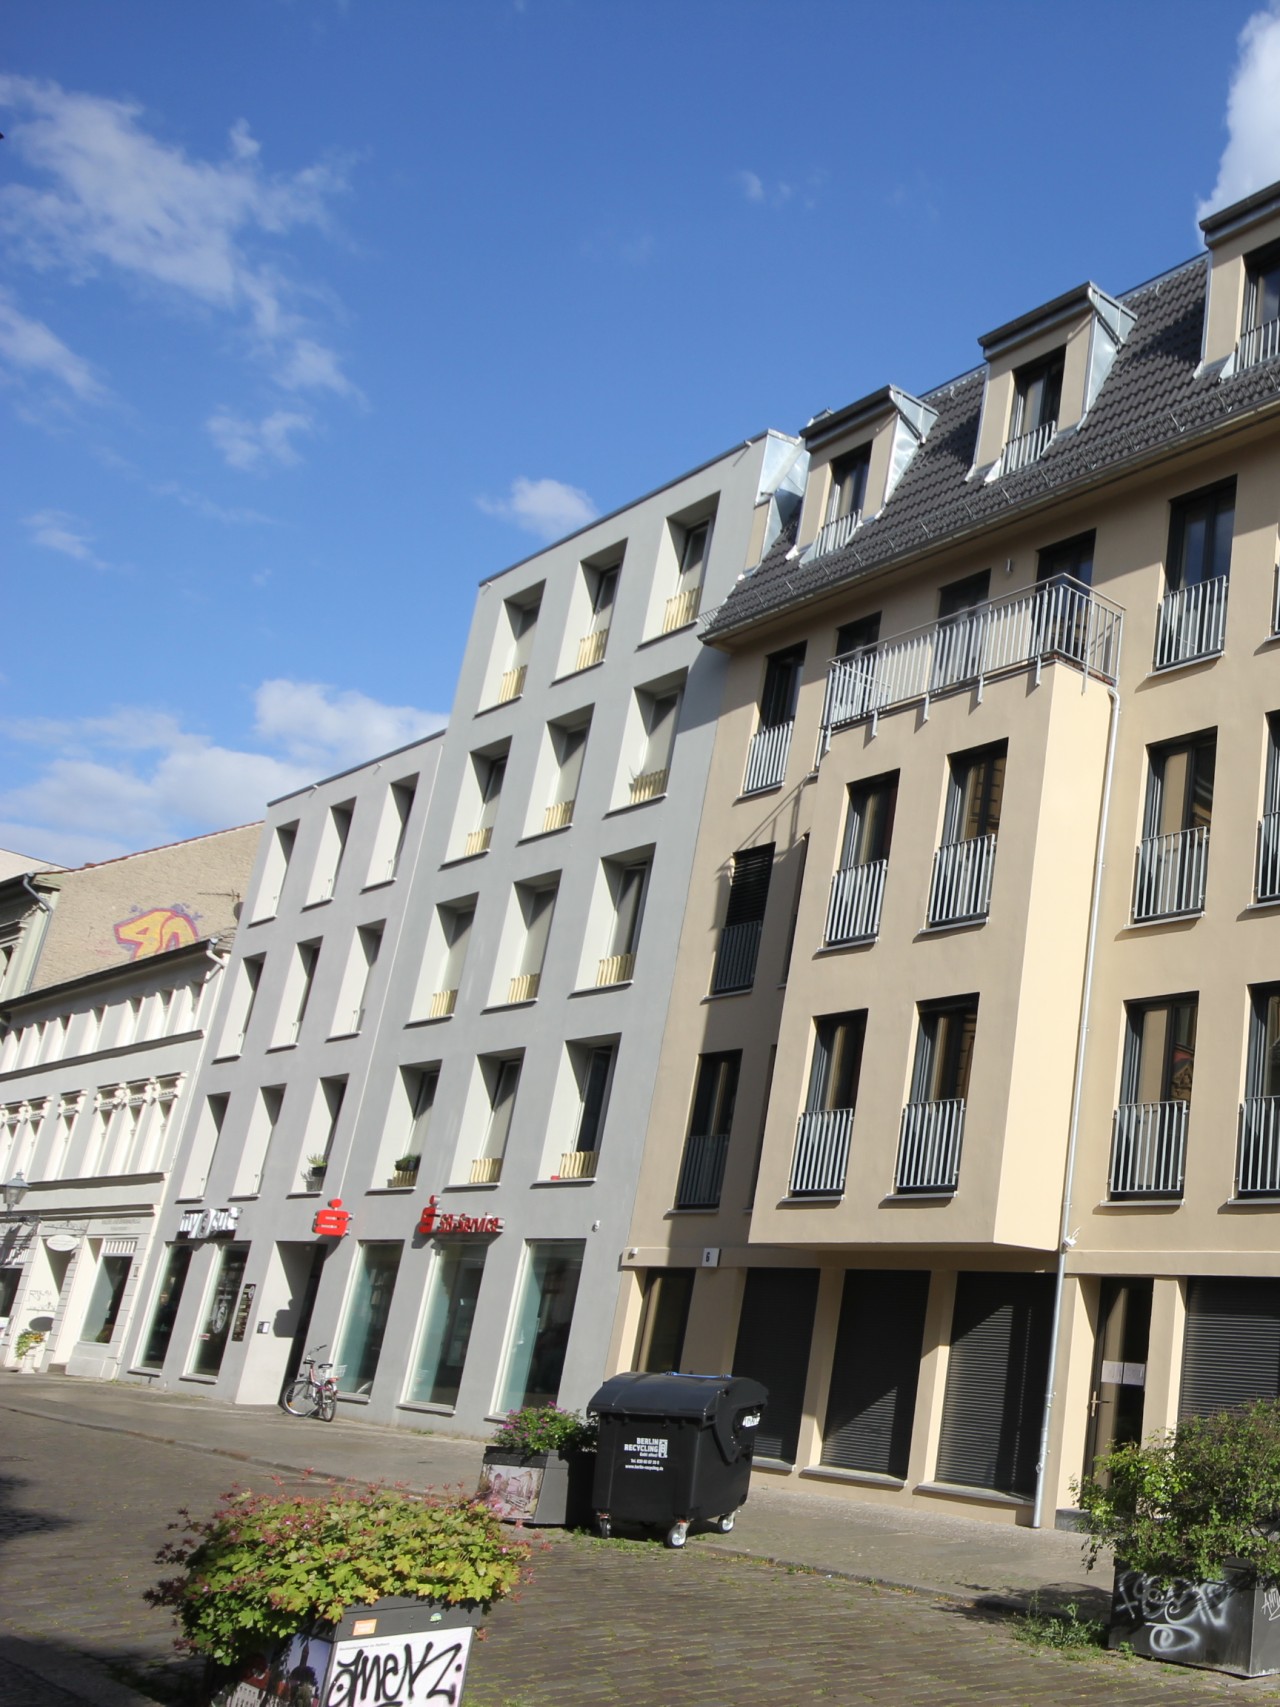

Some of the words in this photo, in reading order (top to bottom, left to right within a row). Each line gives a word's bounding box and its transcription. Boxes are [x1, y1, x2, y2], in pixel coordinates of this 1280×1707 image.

[705, 1251, 711, 1263] 6
[637, 1437, 659, 1445] BERLIN
[624, 1444, 659, 1452] RECYCLING
